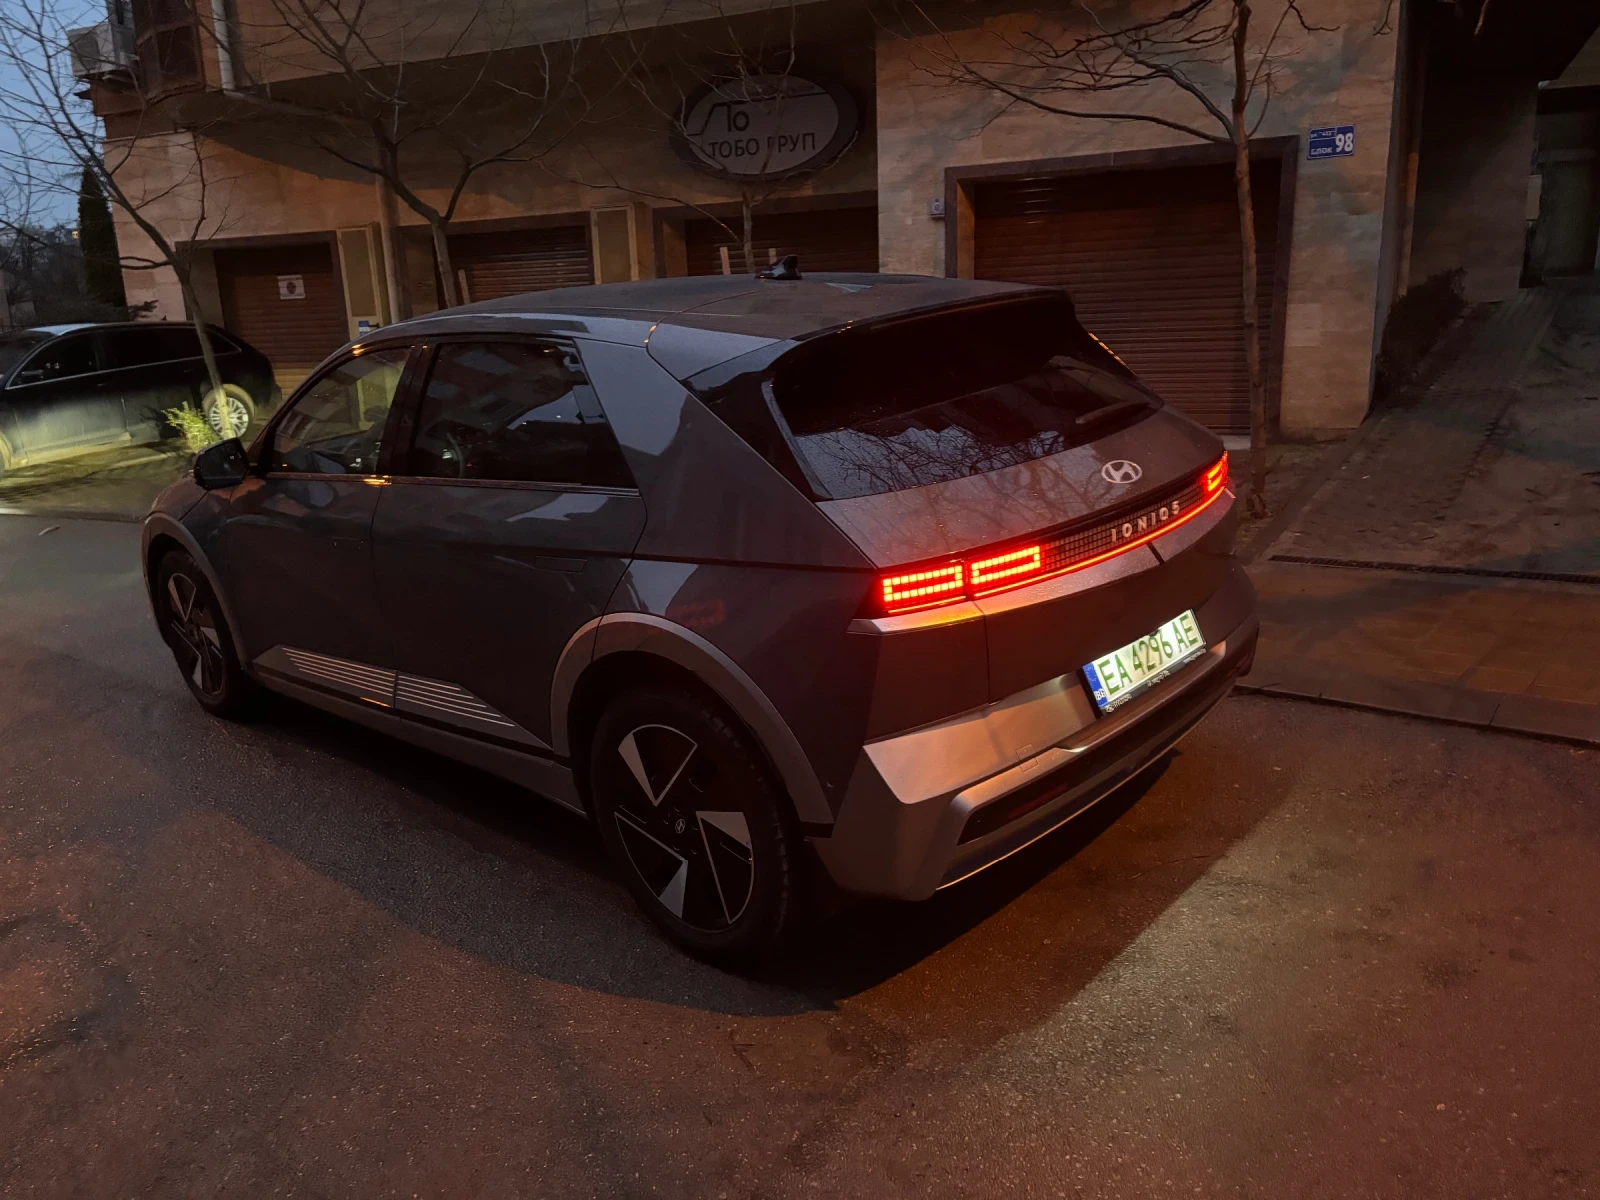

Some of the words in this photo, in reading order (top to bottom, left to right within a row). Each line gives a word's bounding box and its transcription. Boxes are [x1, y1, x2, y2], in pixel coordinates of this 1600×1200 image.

[709, 138, 760, 159] ТОБО
[768, 133, 816, 153] ГРУП
[1336, 133, 1354, 153] 98
[1111, 507, 1169, 542] IONIQ
[1171, 500, 1180, 515] 5
[1098, 654, 1133, 696] EA
[1132, 628, 1174, 676] 4296
[1172, 613, 1199, 654] AE
[1093, 688, 1107, 701] BG
